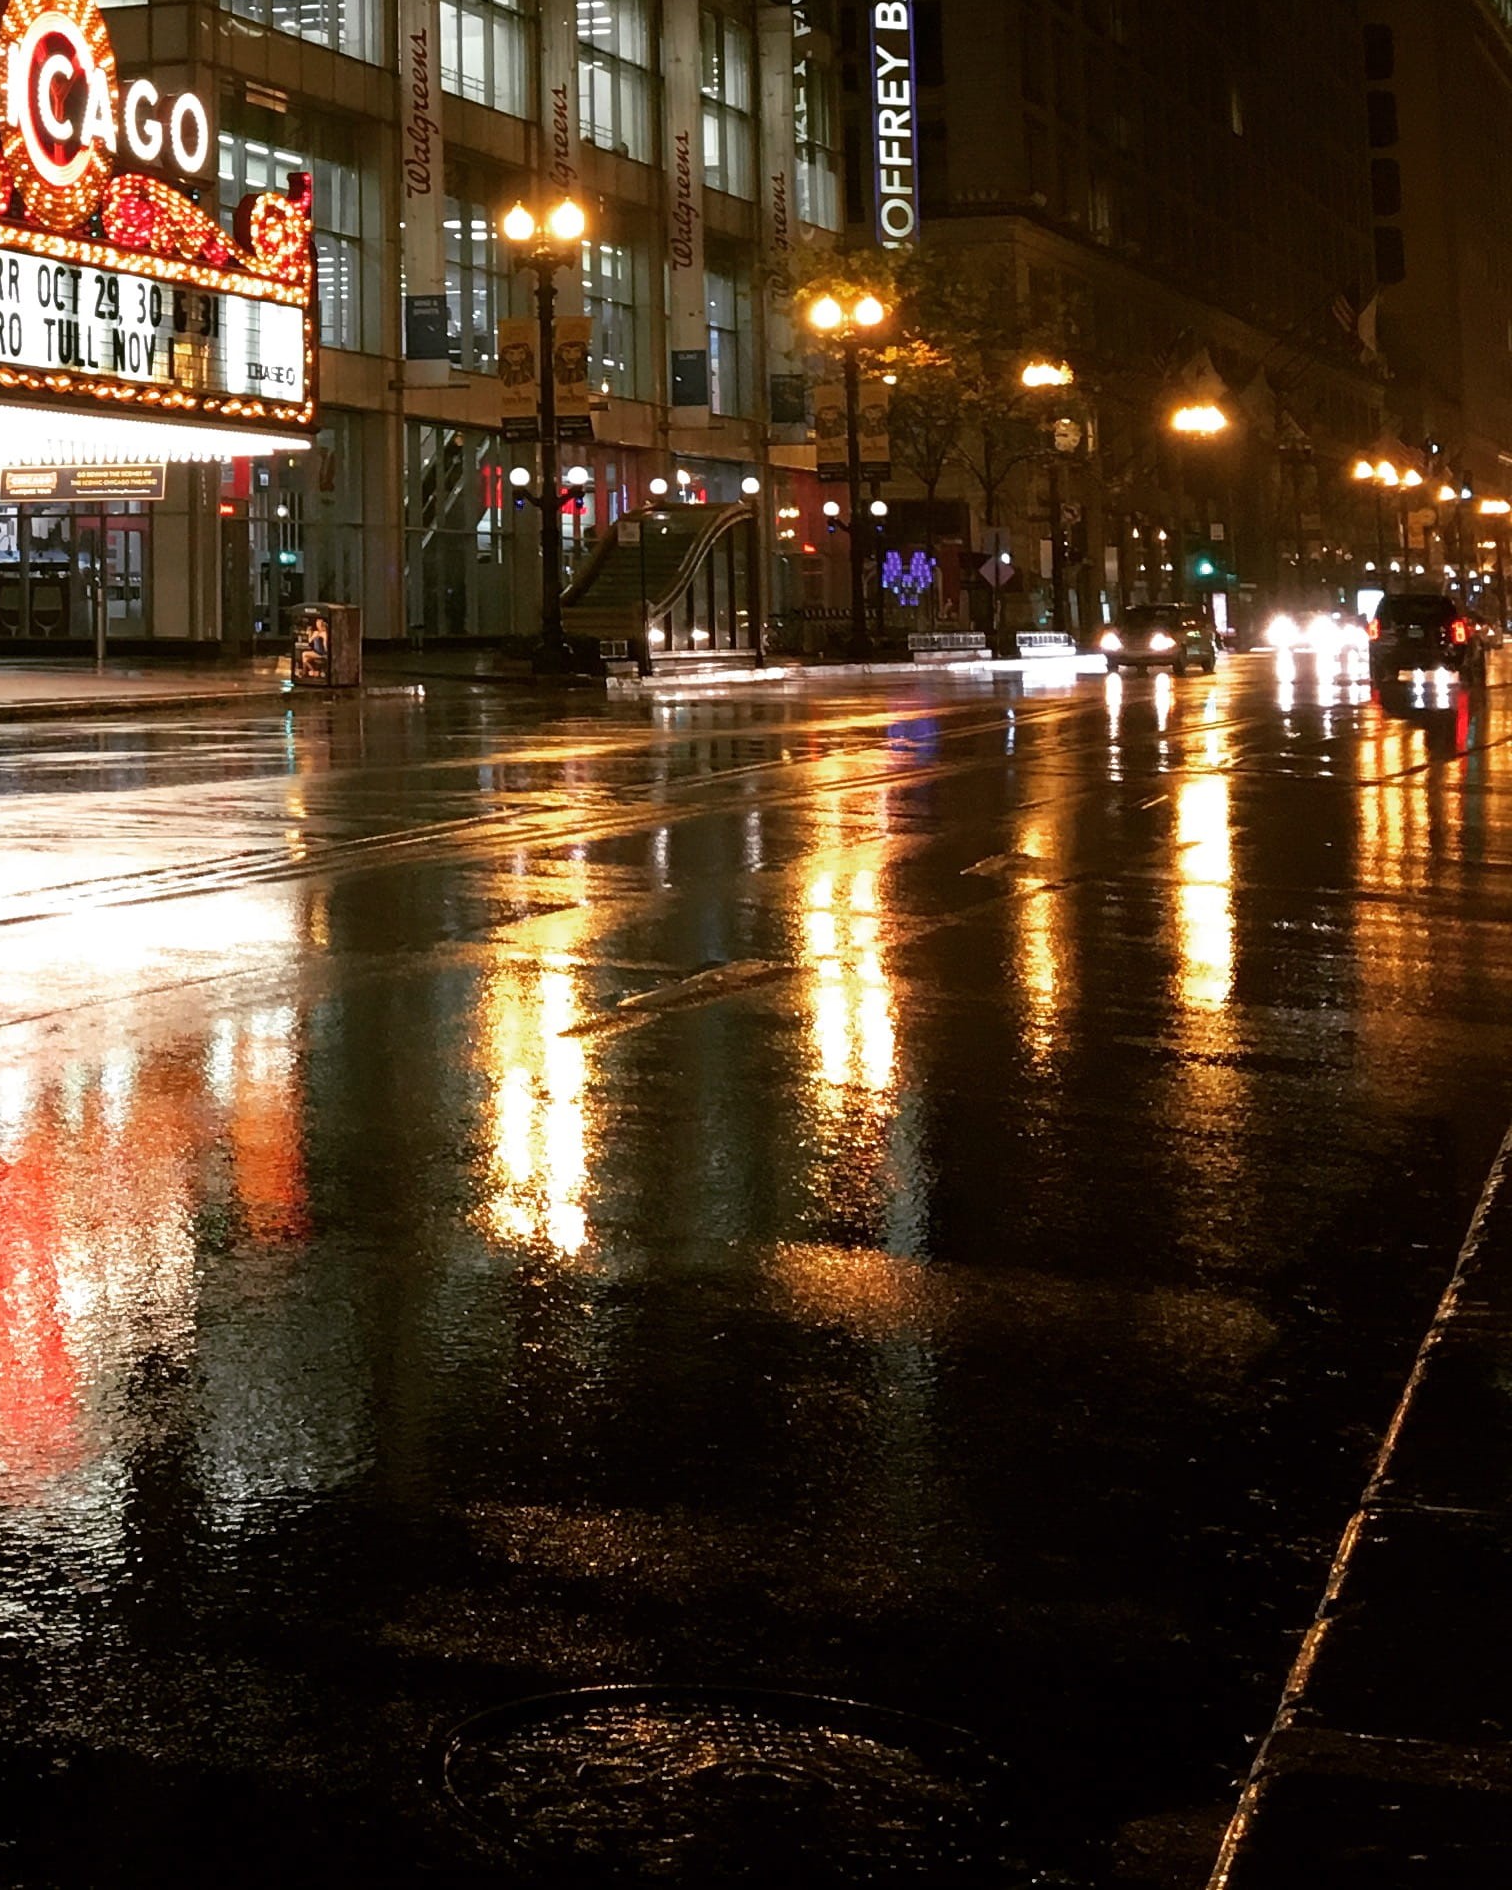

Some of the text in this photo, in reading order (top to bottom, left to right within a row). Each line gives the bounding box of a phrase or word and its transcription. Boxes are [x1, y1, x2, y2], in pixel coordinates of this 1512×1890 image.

[406, 28, 439, 198] Walgreens
[672, 130, 700, 271] Walgreens
[37, 264, 83, 315] OCT
[94, 274, 123, 326] 29,
[137, 283, 162, 328] 30
[43, 318, 99, 369] TULL
[112, 327, 156, 376] NOV
